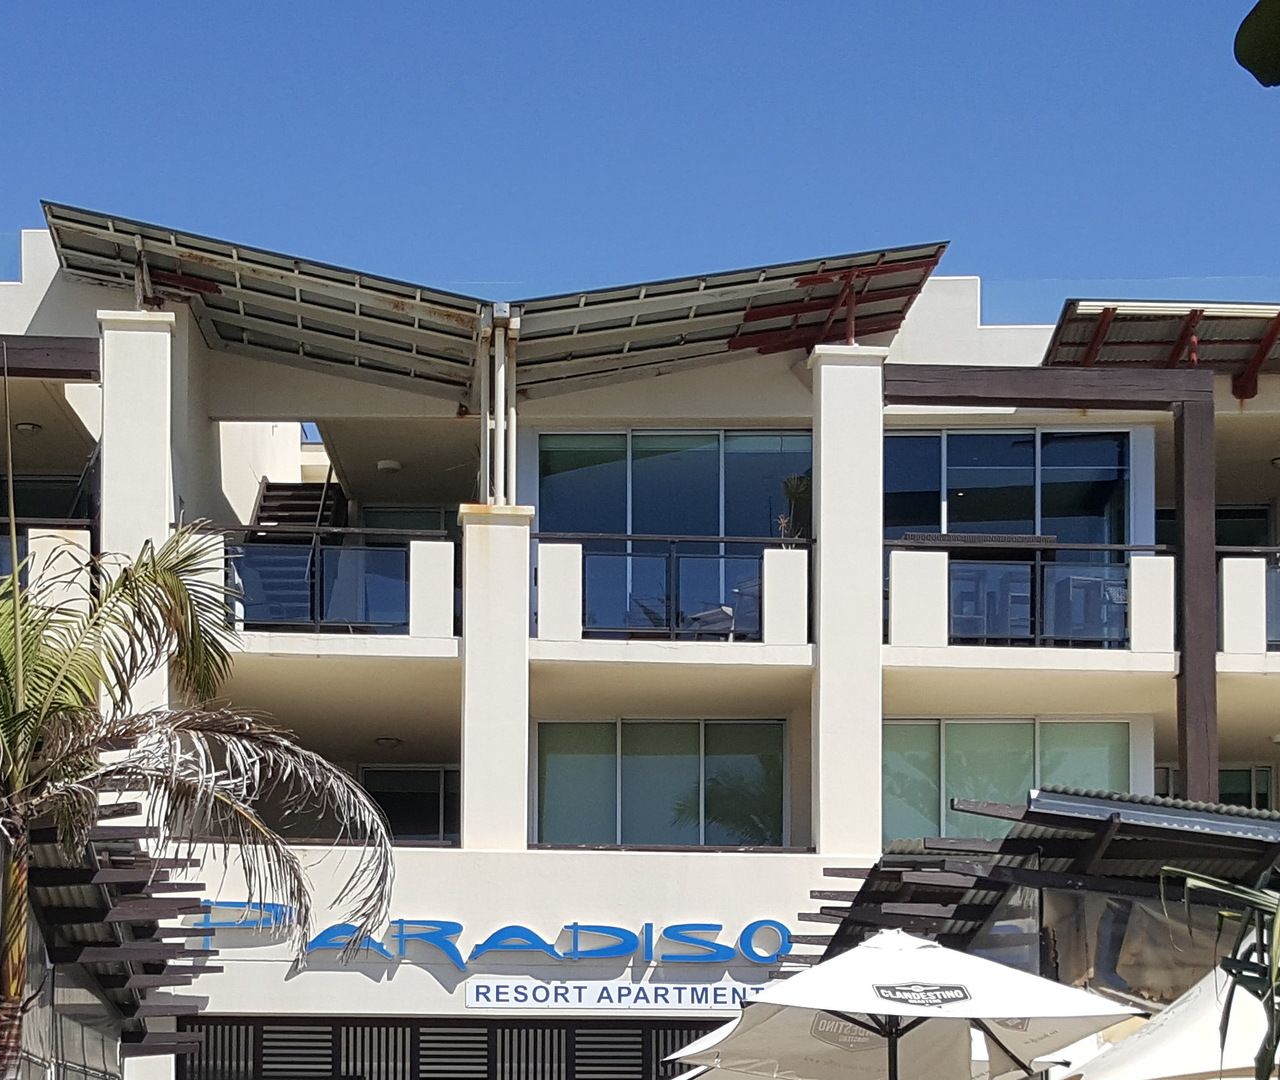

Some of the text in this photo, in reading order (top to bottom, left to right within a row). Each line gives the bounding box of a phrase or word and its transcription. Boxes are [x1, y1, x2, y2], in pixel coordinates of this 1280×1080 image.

[193, 899, 793, 972] PARADISO
[475, 984, 588, 1004] RESORT
[880, 989, 964, 1000] CLANDESTINO
